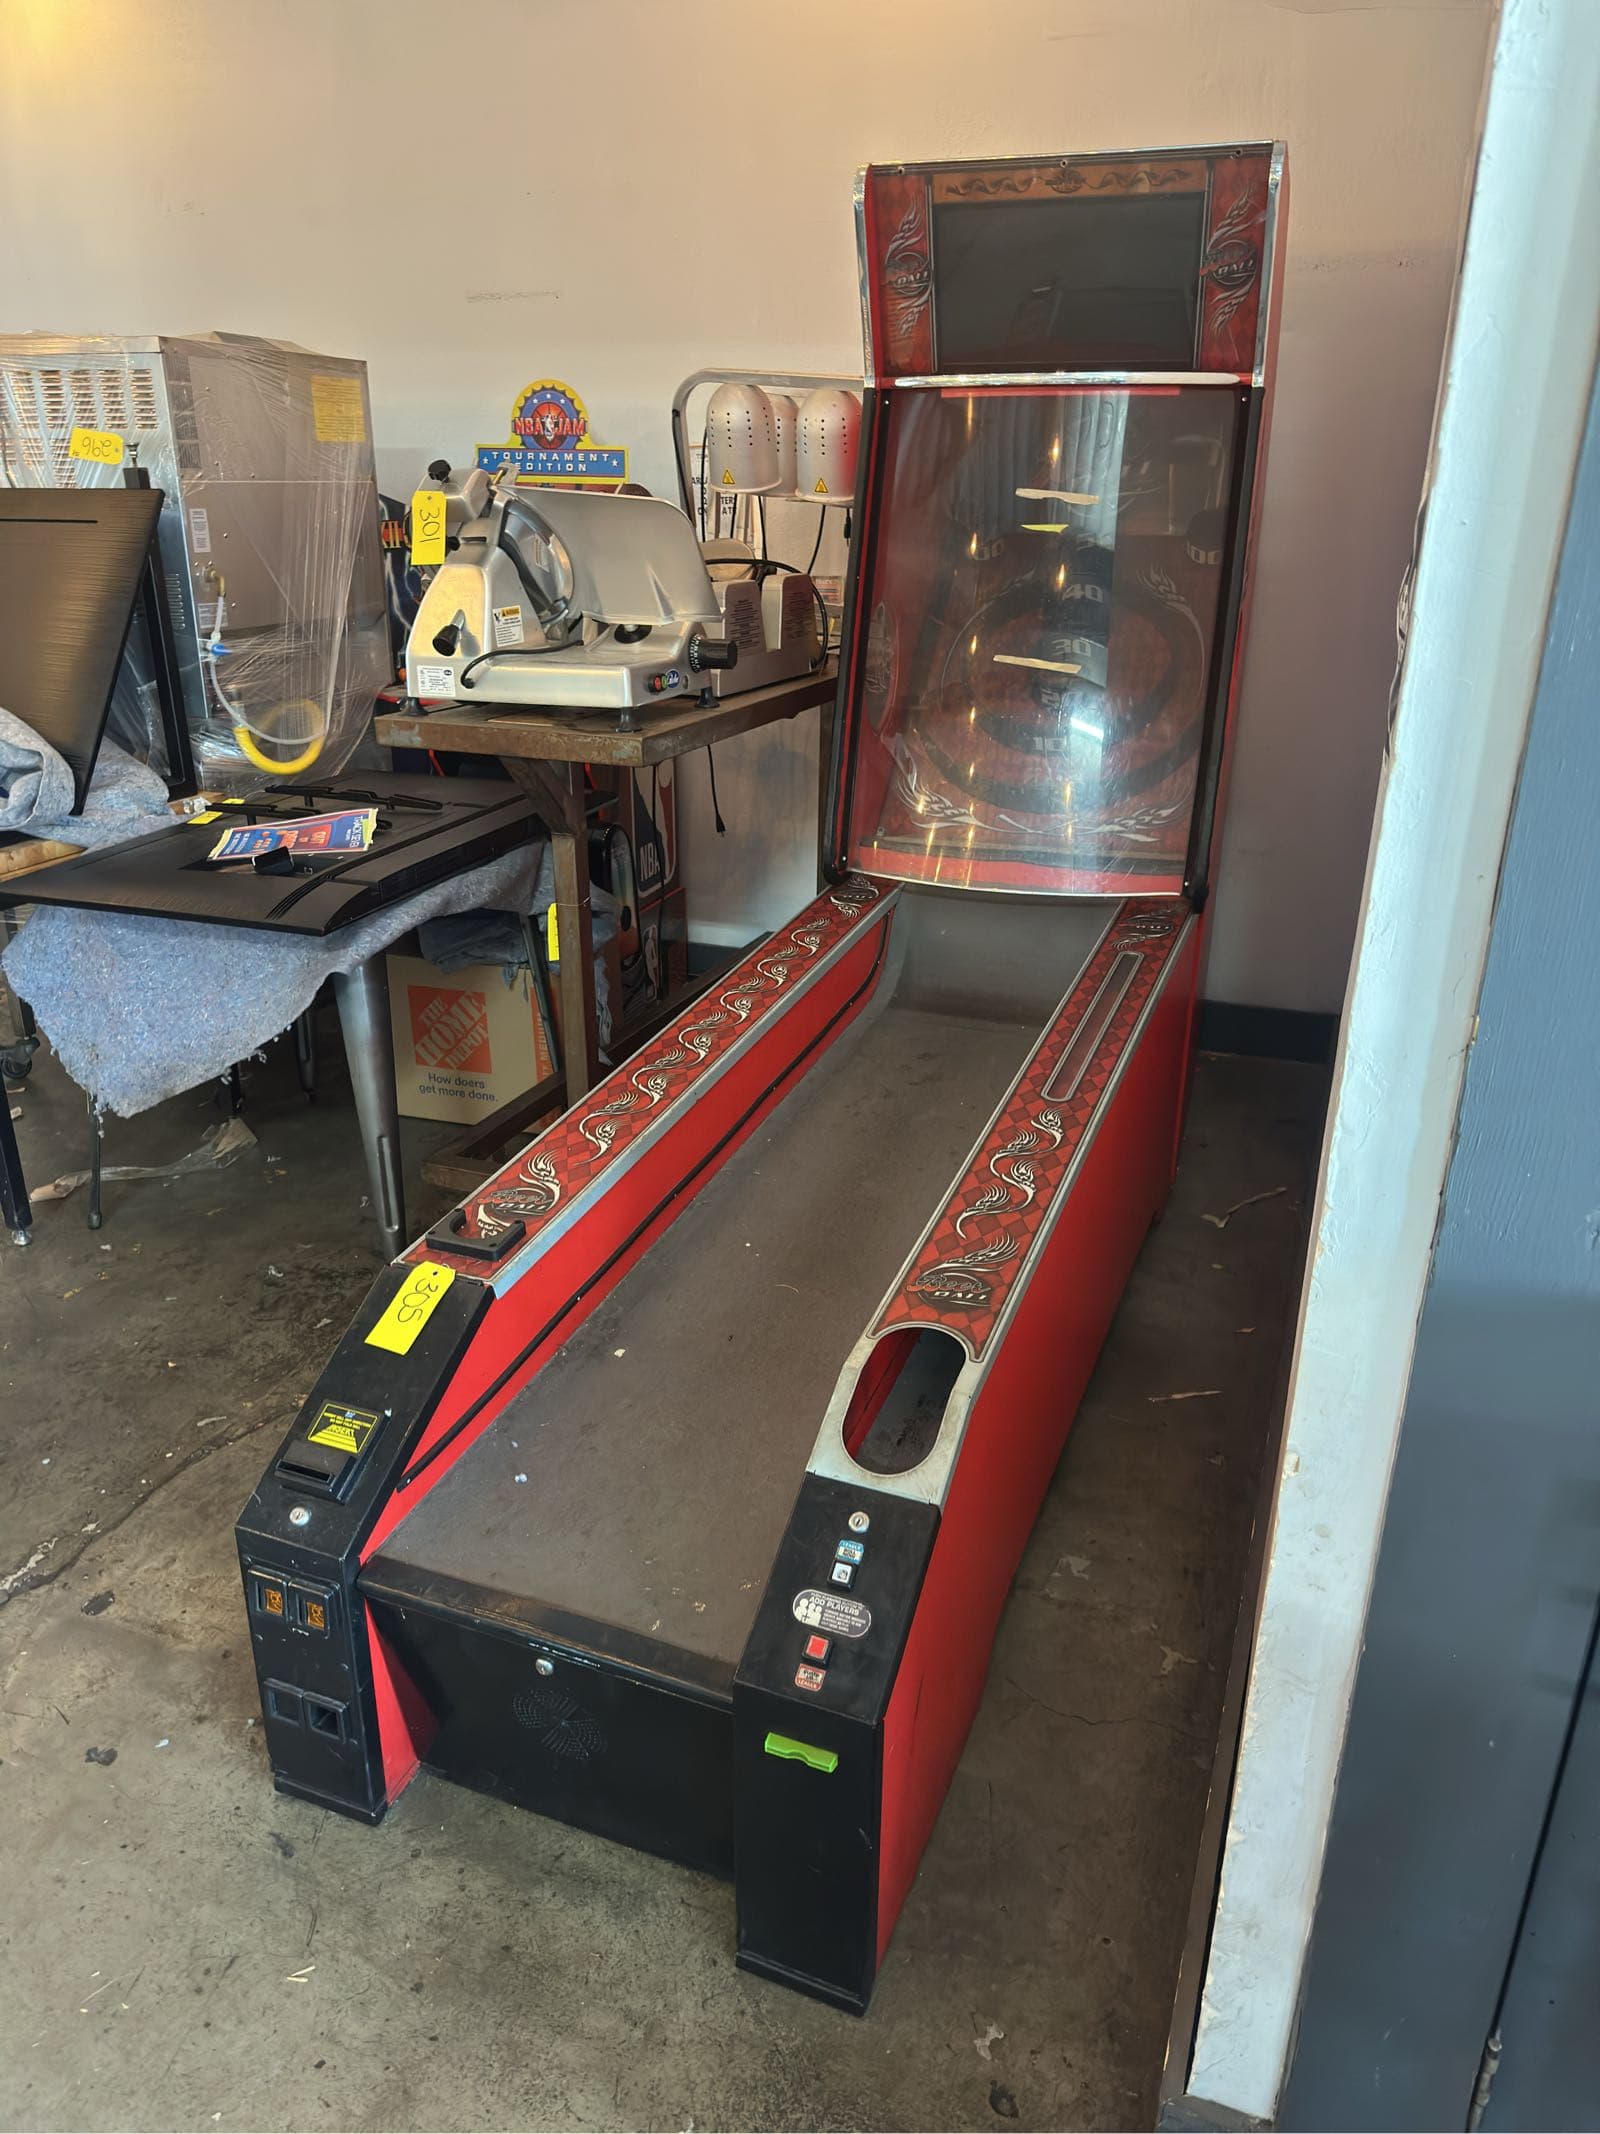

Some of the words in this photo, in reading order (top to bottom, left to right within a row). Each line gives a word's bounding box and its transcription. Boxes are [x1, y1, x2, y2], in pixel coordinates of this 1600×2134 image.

[514, 416, 544, 437] NBA
[553, 417, 587, 437] JAM
[491, 451, 611, 463] TOURNAMENT
[516, 462, 588, 472] EDITION
[419, 507, 441, 543] 301
[1062, 583, 1105, 603] 40
[1052, 637, 1093, 657] 30
[640, 842, 661, 882] NBA
[418, 997, 447, 1026] THE
[415, 991, 488, 1067] HOME
[444, 1021, 489, 1069] DEPOT
[428, 1072, 452, 1084] How
[454, 1074, 486, 1090] doers
[418, 1084, 436, 1095] get
[438, 1087, 466, 1098] more
[468, 1089, 498, 1102] done.
[397, 1277, 439, 1323] 305
[809, 1595, 826, 1606] ADD
[826, 1600, 860, 1616] PLAYERS
